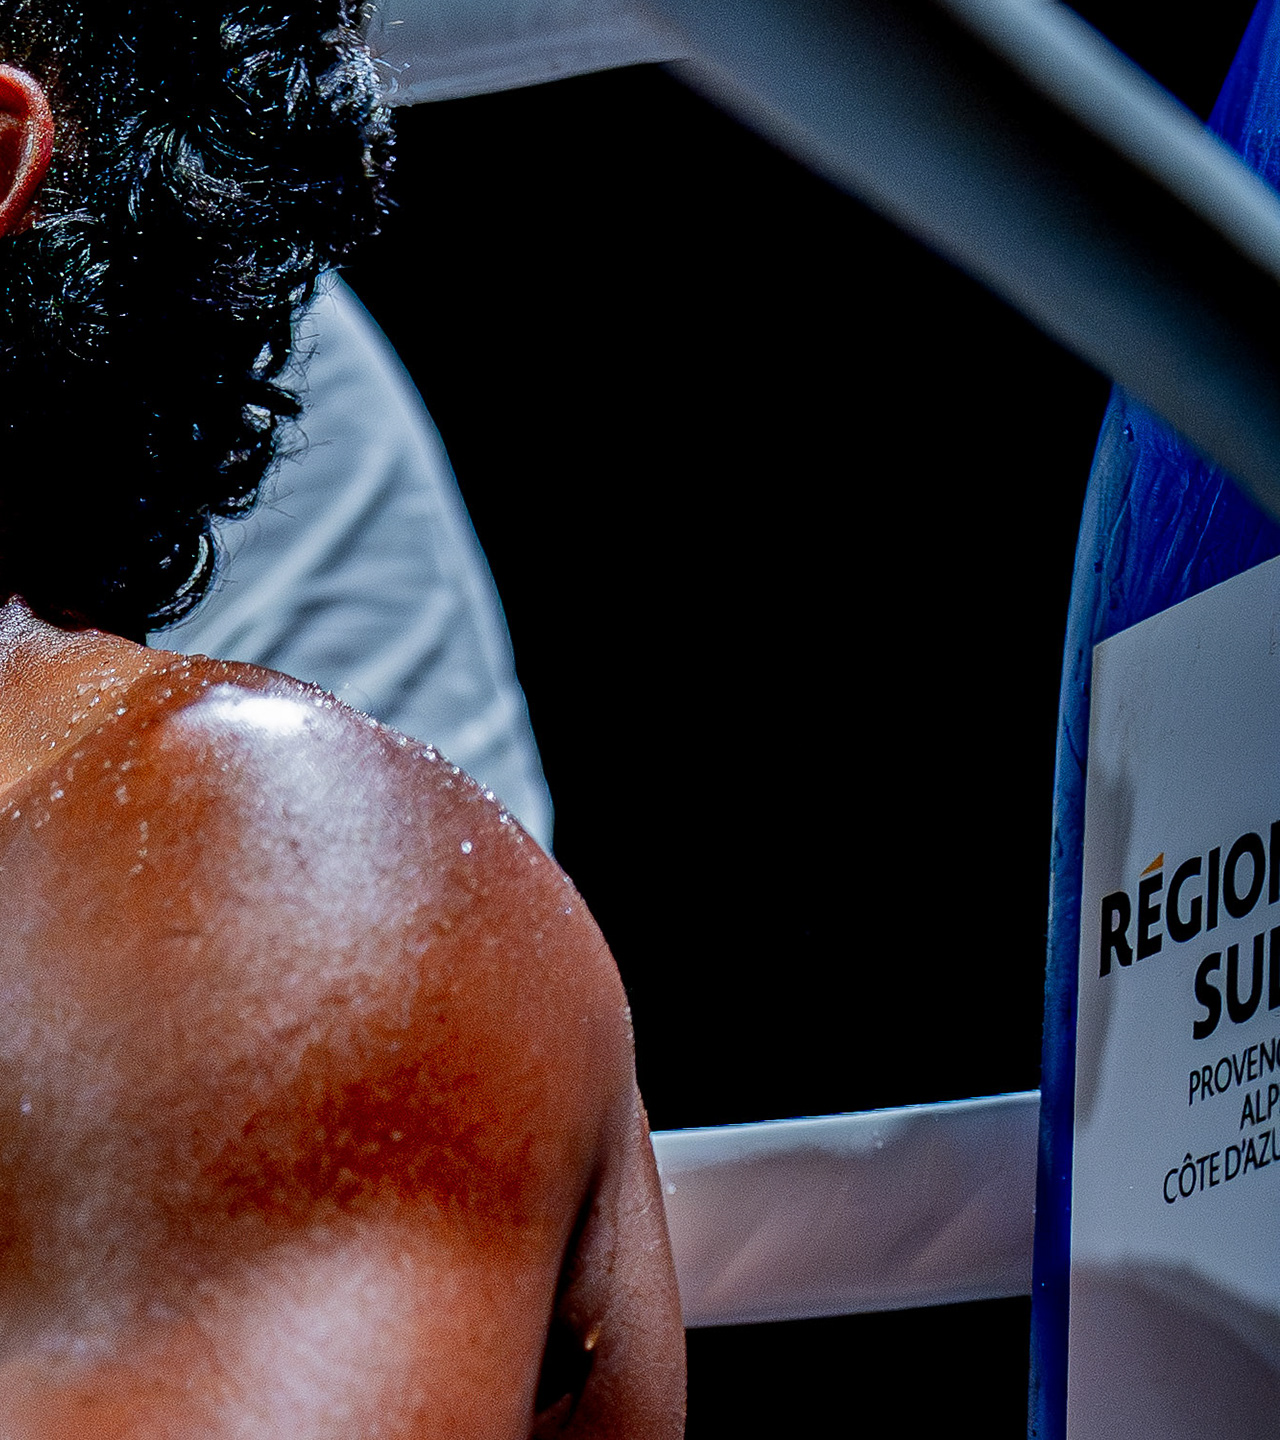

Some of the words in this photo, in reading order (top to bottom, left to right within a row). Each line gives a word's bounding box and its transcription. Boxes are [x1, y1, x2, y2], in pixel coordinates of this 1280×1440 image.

[1189, 1037, 1280, 1107] PROVEN
[1240, 1083, 1280, 1130] ALP
[1163, 1152, 1221, 1204] CÔTE
